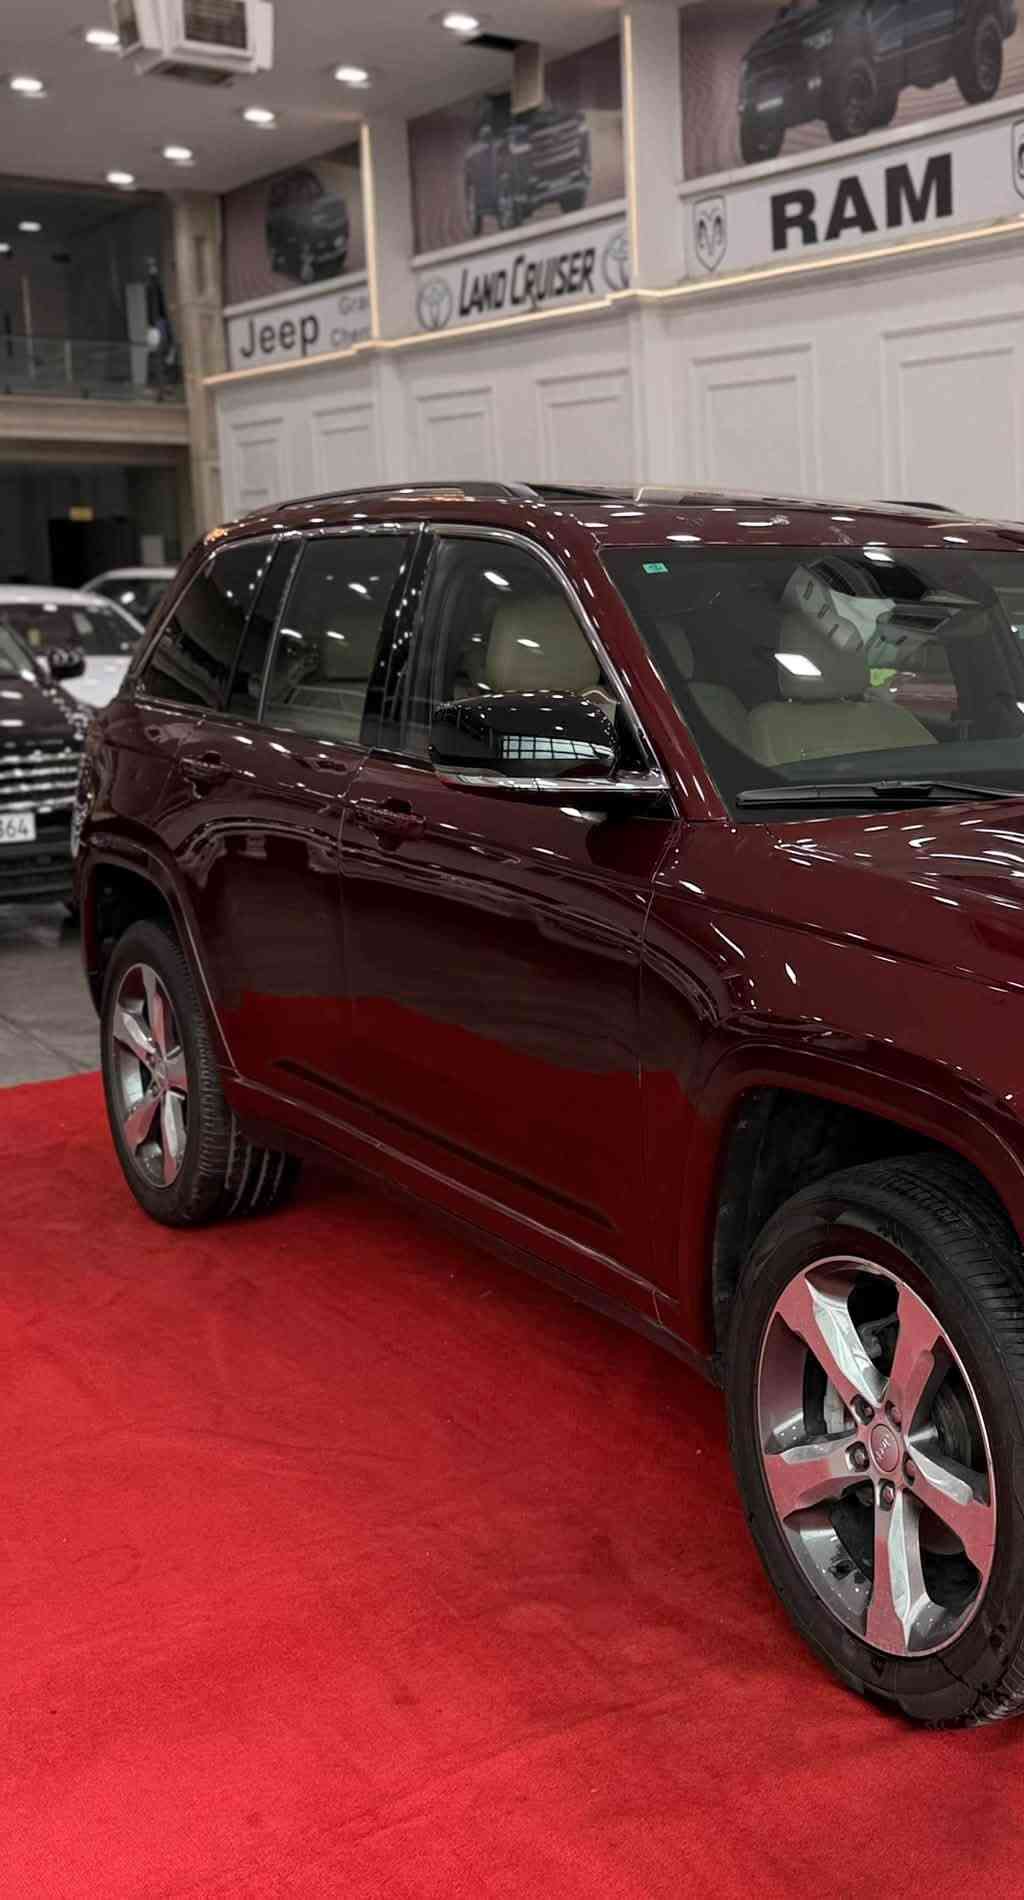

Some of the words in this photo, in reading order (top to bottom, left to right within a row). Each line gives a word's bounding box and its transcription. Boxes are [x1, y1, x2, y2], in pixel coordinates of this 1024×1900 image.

[771, 153, 953, 251] RAM
[459, 268, 508, 317] LAND
[511, 248, 596, 311] CRUISER
[240, 315, 319, 358] Jeep
